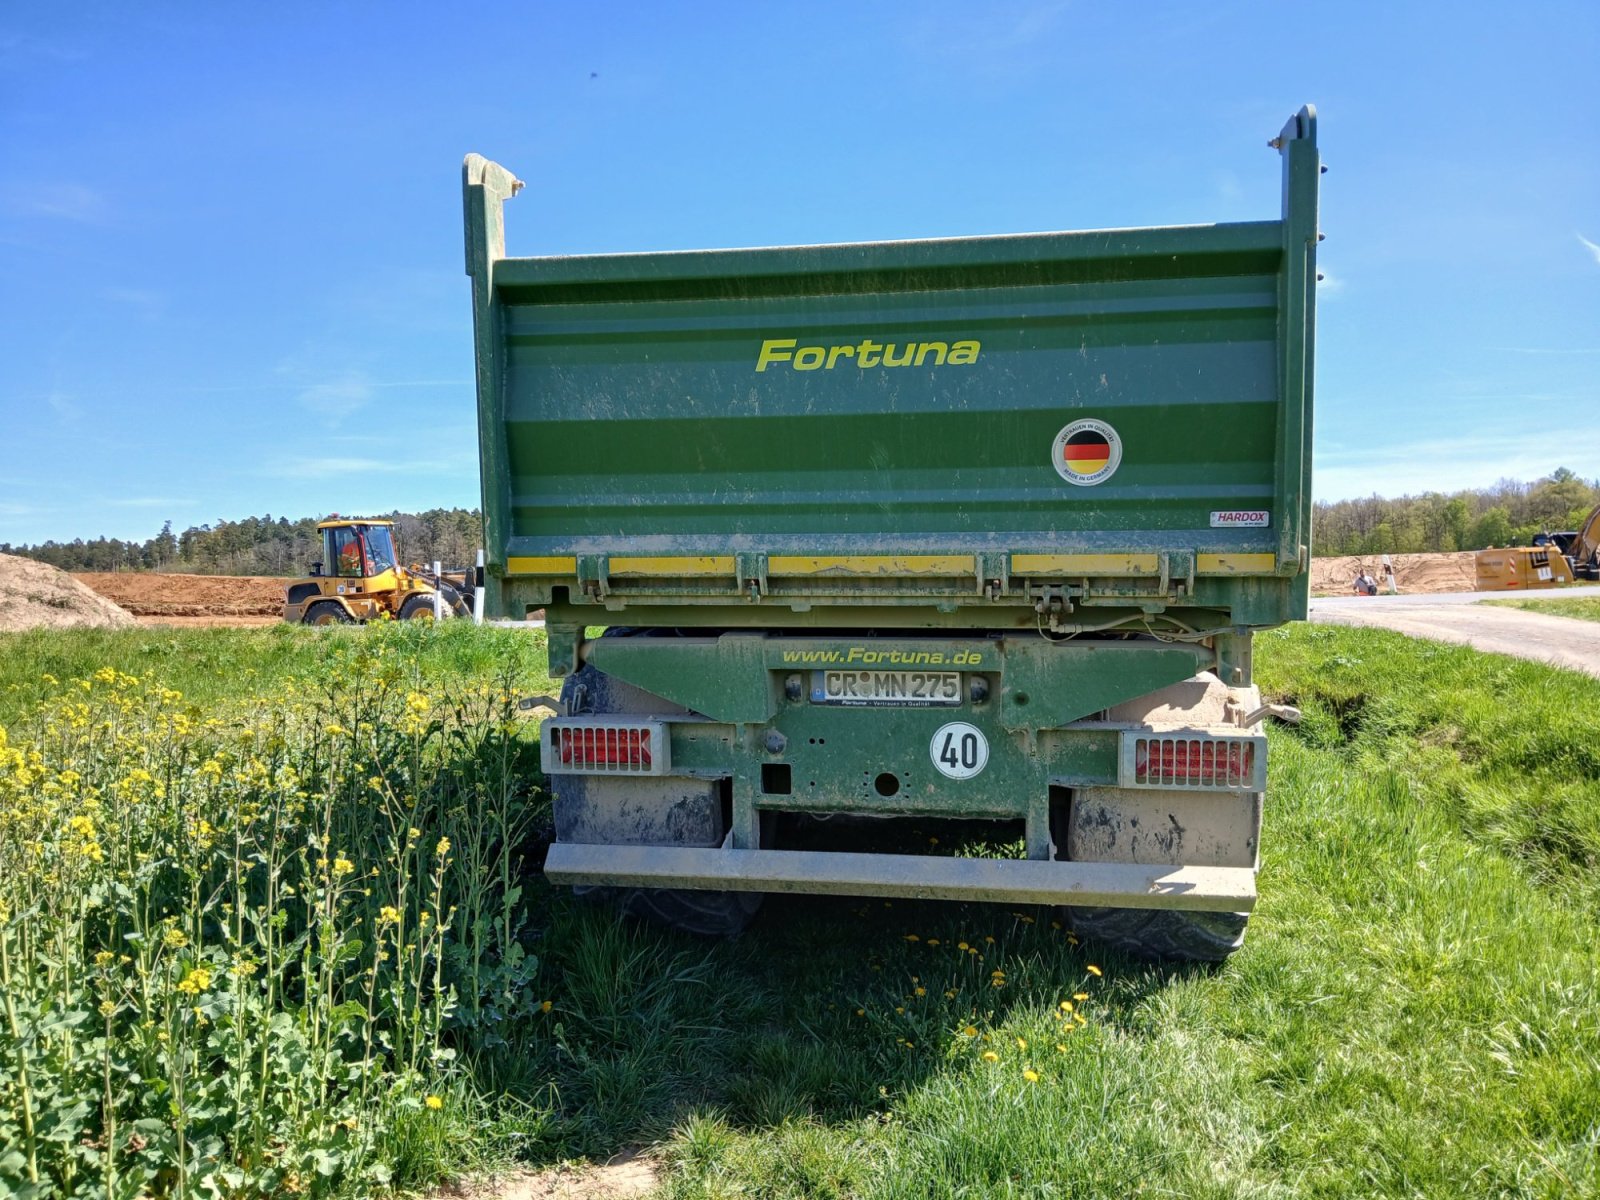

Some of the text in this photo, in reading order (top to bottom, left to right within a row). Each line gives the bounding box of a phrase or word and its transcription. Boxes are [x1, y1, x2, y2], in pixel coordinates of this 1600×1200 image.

[755, 338, 981, 372] Fortuna
[1064, 468, 1078, 480] MADE
[1086, 465, 1110, 481] GERMANY
[1217, 512, 1265, 522] HARDOX
[783, 647, 982, 665] www.Fortuna.de
[826, 672, 958, 698] CR MN 275
[940, 732, 978, 769] 40
